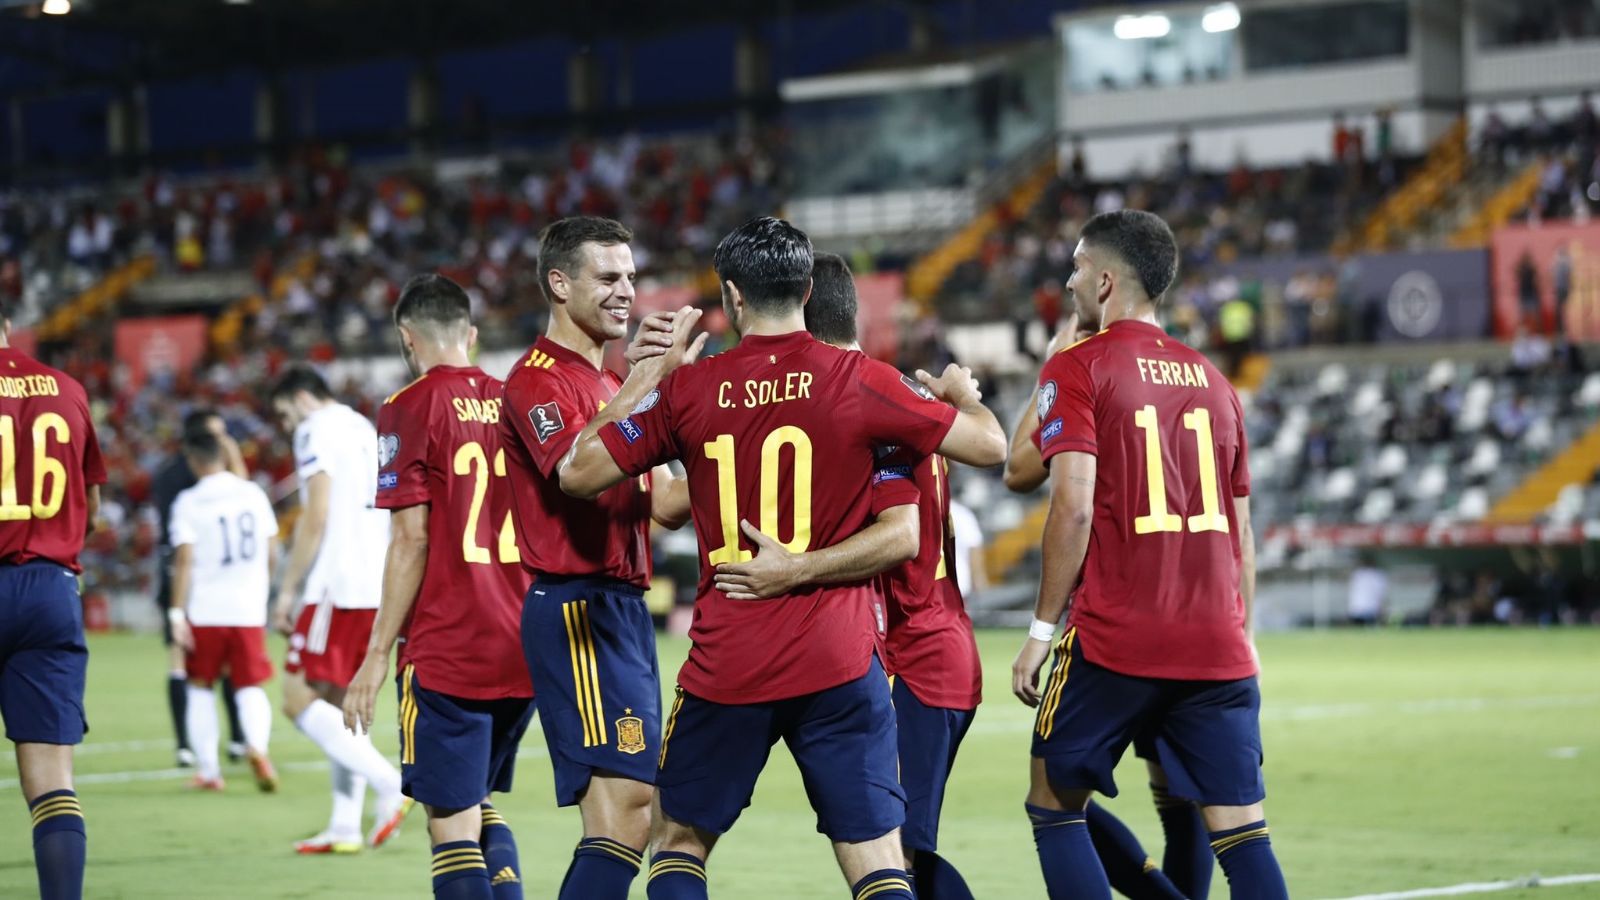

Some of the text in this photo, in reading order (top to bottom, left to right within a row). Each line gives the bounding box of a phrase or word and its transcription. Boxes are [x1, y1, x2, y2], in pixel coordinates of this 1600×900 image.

[0, 375, 59, 398] ODRIGO
[718, 372, 813, 408] C. SOLER
[1137, 357, 1209, 389] FERRAN
[453, 397, 503, 424] SARAB
[621, 419, 640, 440] ESPECT
[0, 412, 70, 521] 16
[1134, 404, 1230, 534] 11
[703, 425, 813, 566] 10
[218, 511, 257, 566] 18
